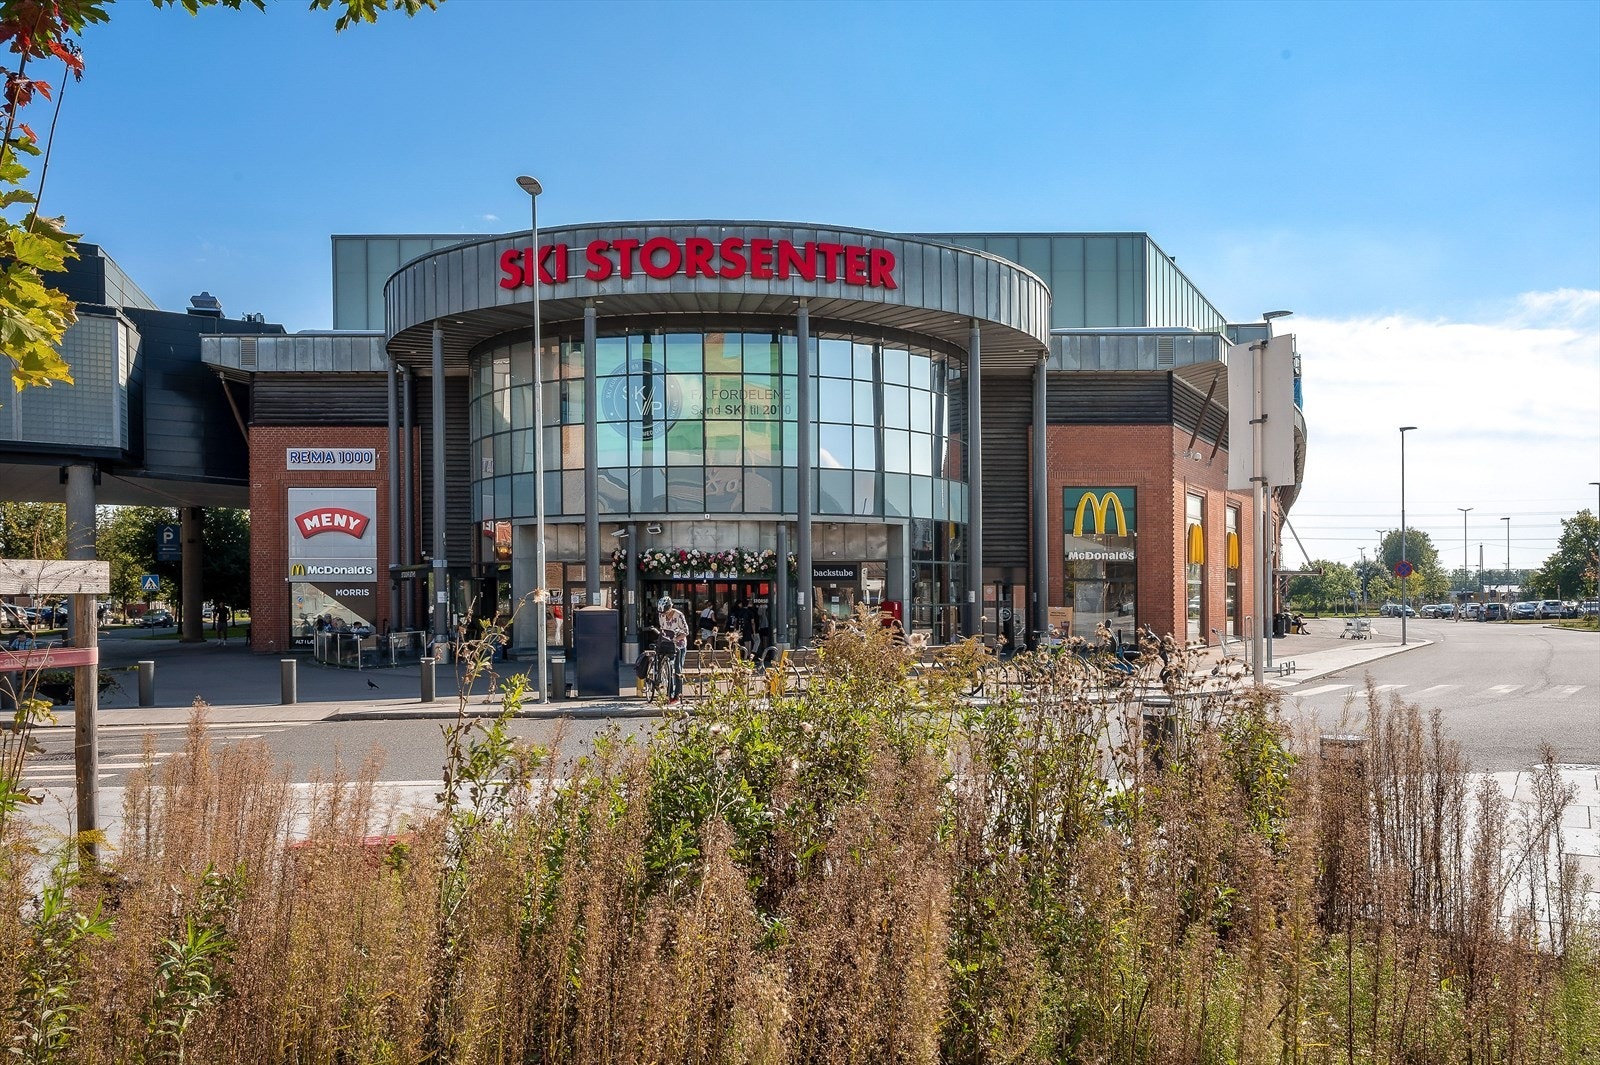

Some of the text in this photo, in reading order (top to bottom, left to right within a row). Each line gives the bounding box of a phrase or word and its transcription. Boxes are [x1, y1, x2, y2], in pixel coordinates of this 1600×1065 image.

[500, 236, 898, 290] SKI STORSENTER
[711, 389, 791, 399] FORDELENE
[750, 405, 759, 415] til
[290, 451, 373, 463] REMA 1000
[303, 513, 361, 531] MENY
[1068, 551, 1135, 560] McDonald's
[307, 565, 373, 575] McDonald's
[813, 569, 854, 577] backstube
